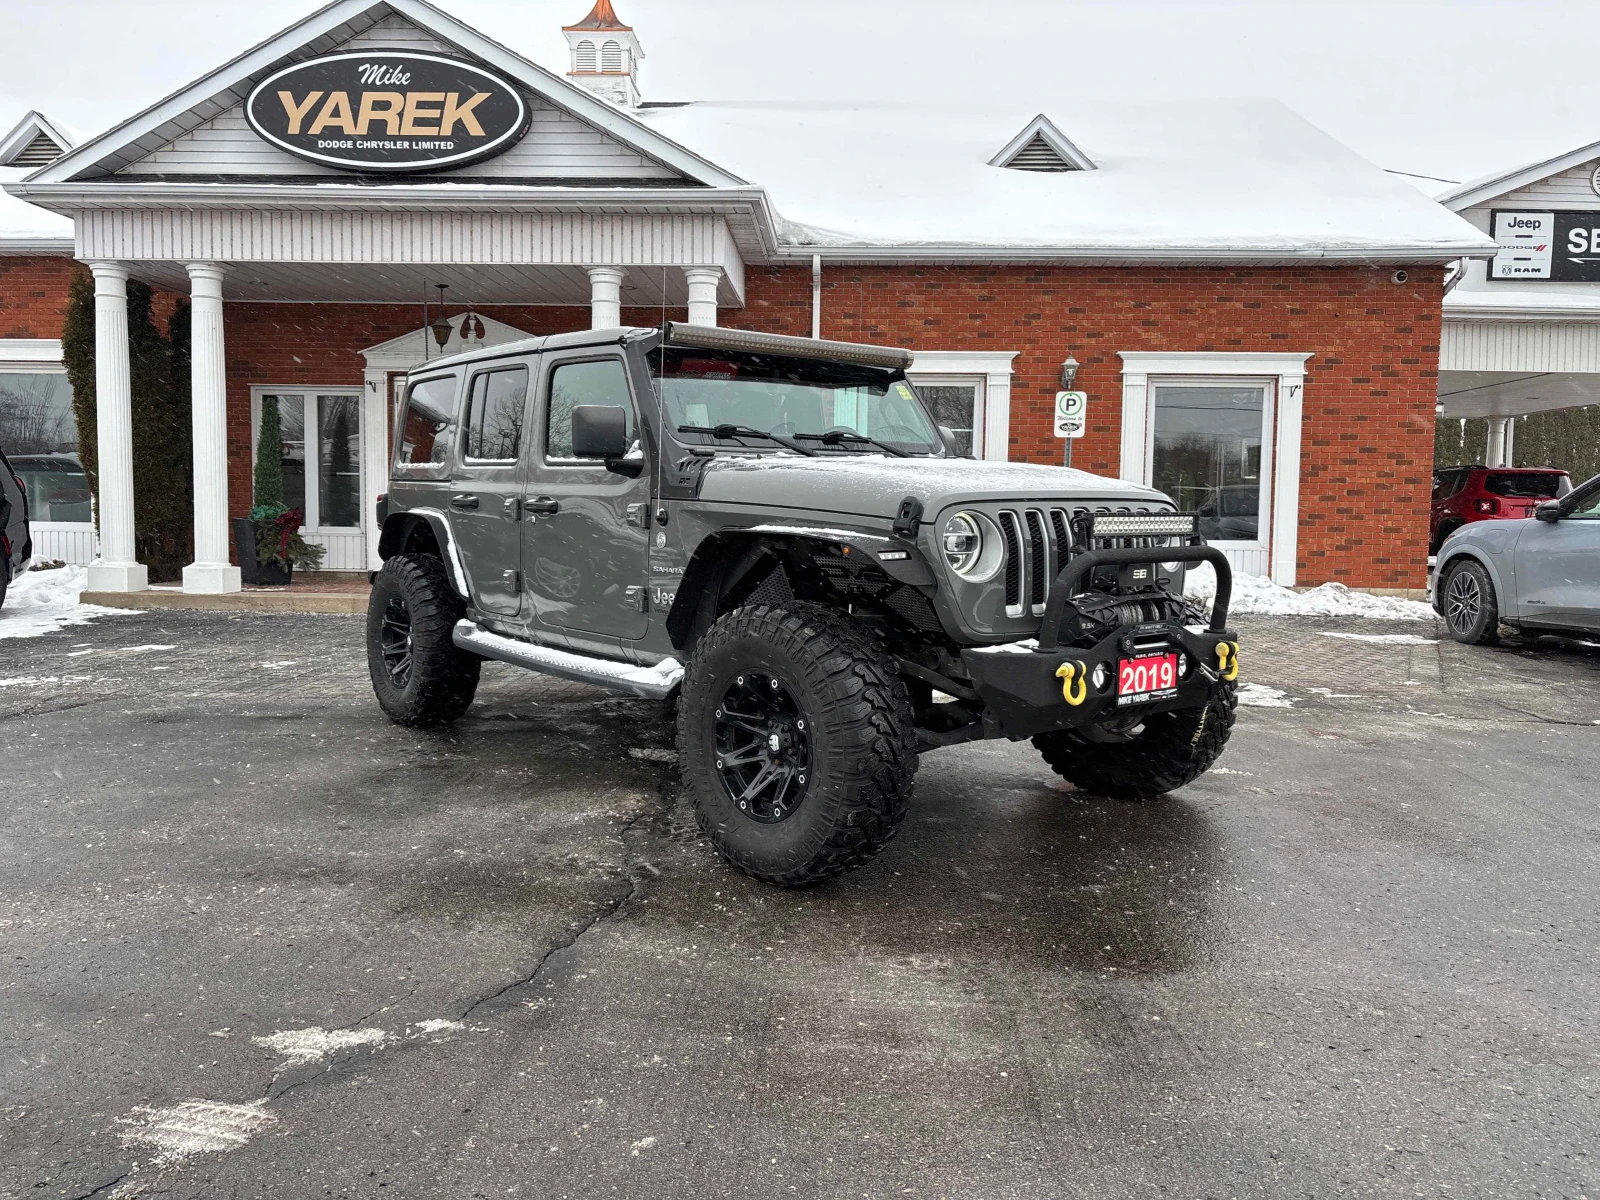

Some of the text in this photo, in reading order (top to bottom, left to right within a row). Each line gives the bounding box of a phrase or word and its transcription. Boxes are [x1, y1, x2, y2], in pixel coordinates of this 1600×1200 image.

[358, 64, 411, 85] Mike
[277, 91, 492, 136] YAREK
[318, 140, 454, 150] DODGE CHRYSLER LIMITED
[1508, 217, 1541, 230] Jeep
[1066, 398, 1077, 411] P
[653, 565, 683, 574] SAHARA
[653, 588, 675, 604] Jee
[1122, 662, 1172, 694] 2019
[1118, 696, 1132, 705] MIKE
[1132, 693, 1150, 702] YAREK
